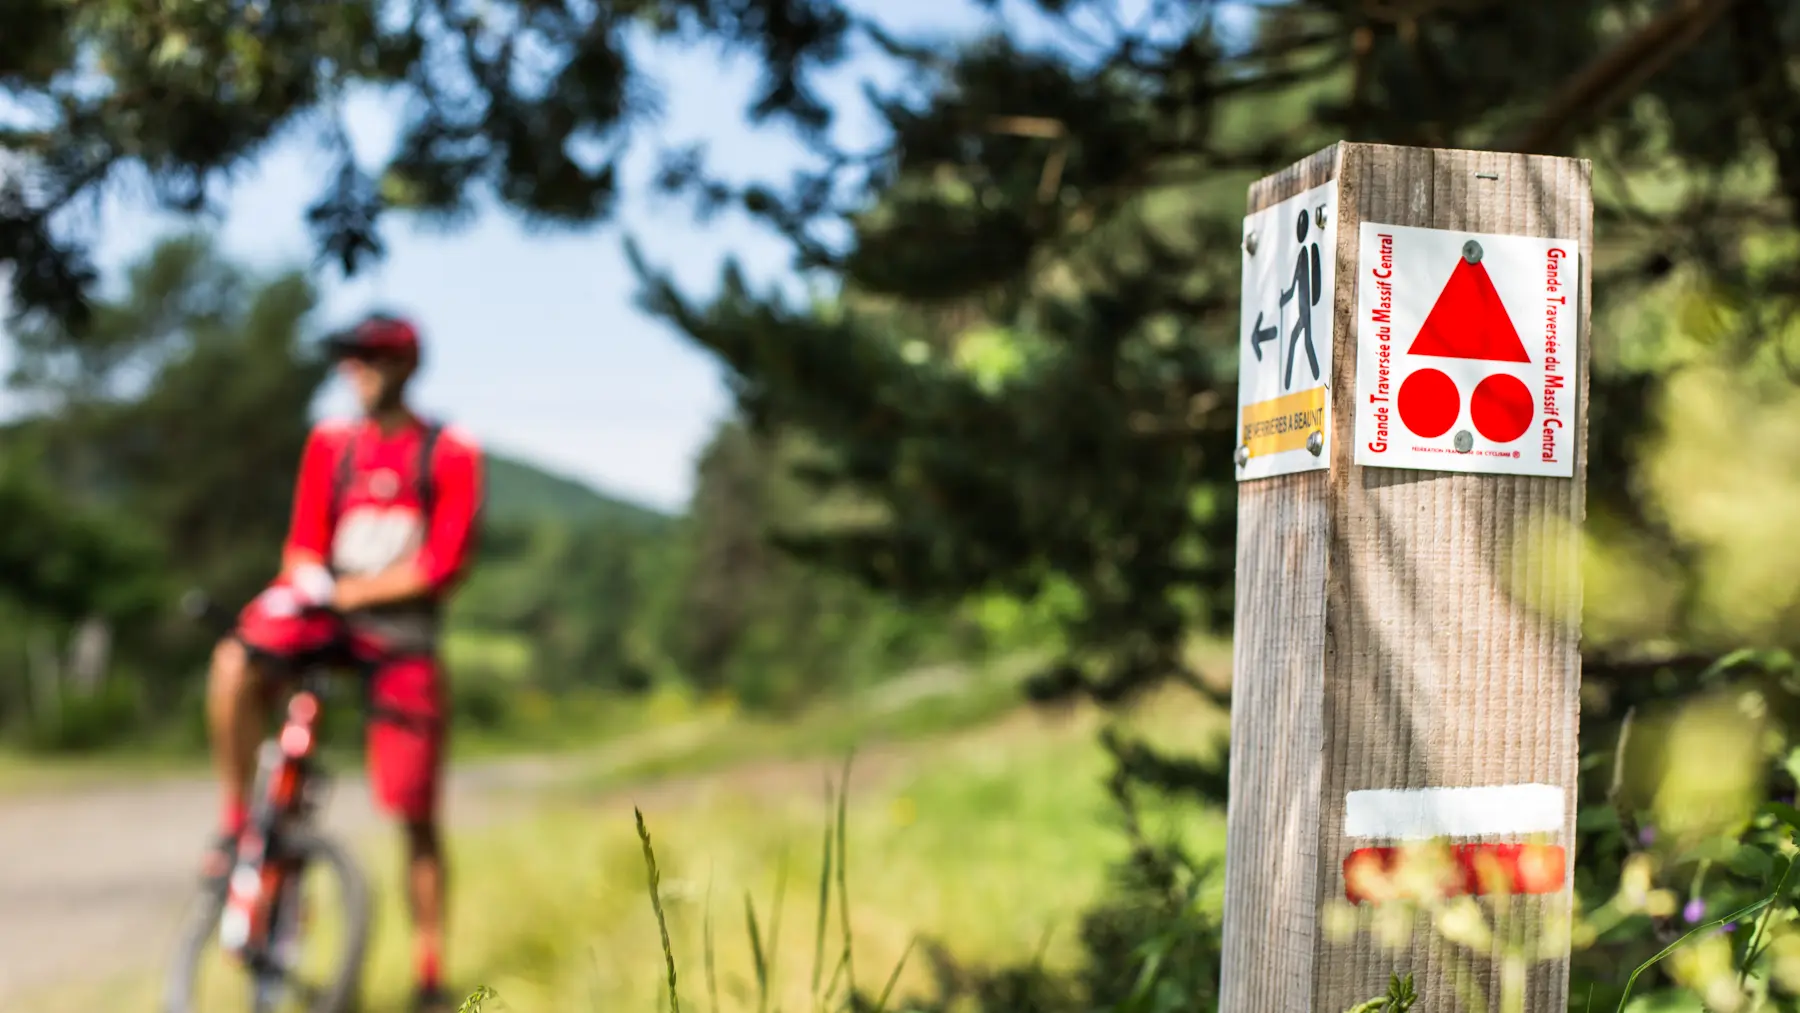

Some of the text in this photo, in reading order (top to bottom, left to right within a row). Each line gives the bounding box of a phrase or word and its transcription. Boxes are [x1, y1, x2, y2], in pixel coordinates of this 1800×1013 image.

[1368, 234, 1393, 453] Grande Traversée du Massif Central
[1541, 248, 1567, 463] Grande Traversée du Massif Central
